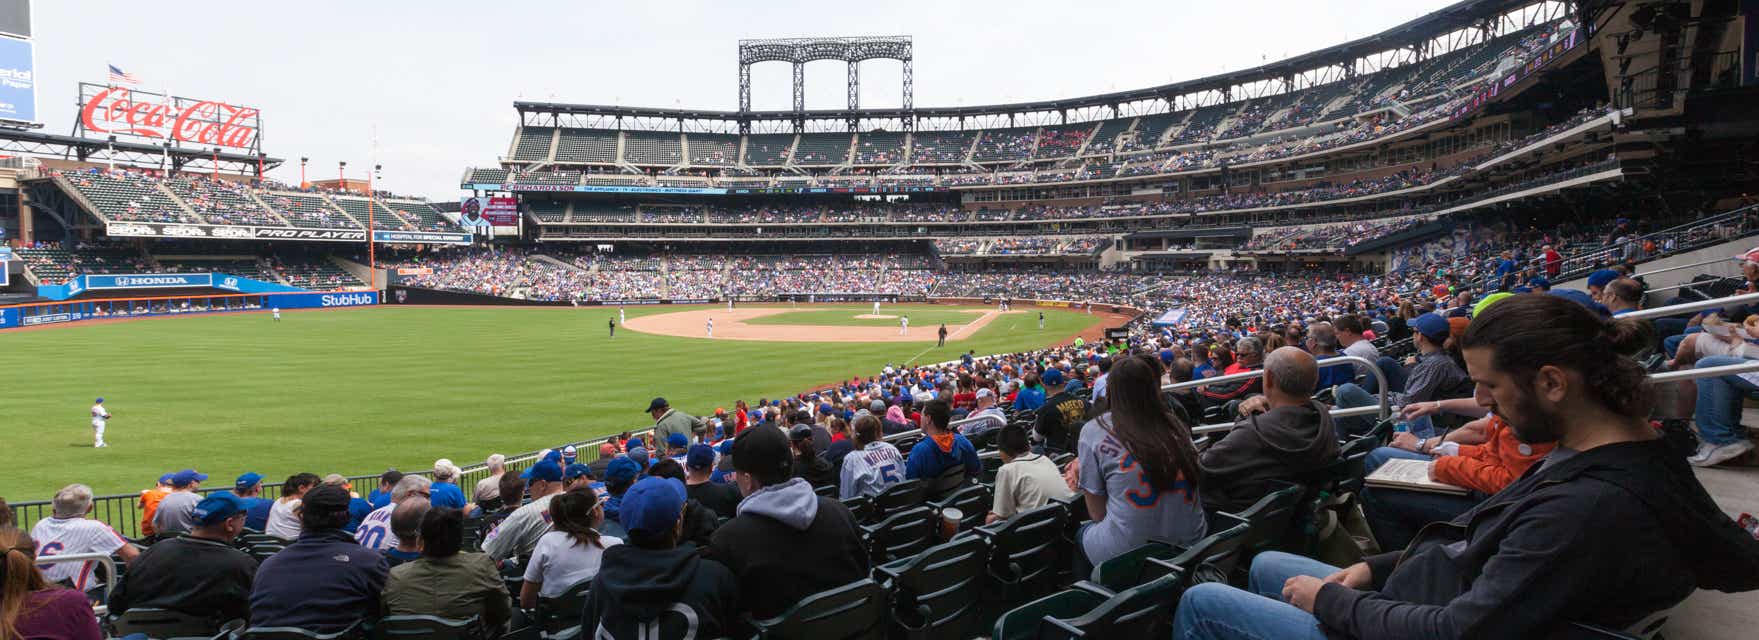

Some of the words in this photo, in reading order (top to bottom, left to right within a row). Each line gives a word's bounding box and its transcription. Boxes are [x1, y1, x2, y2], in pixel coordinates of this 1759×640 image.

[82, 87, 258, 148] Coca-Cola
[256, 229, 299, 237] PRO
[297, 230, 364, 239] PLAYER
[131, 277, 188, 285] HONDA
[321, 294, 372, 306] StubHub
[863, 447, 897, 467] WRIGHT
[880, 464, 900, 483] 5
